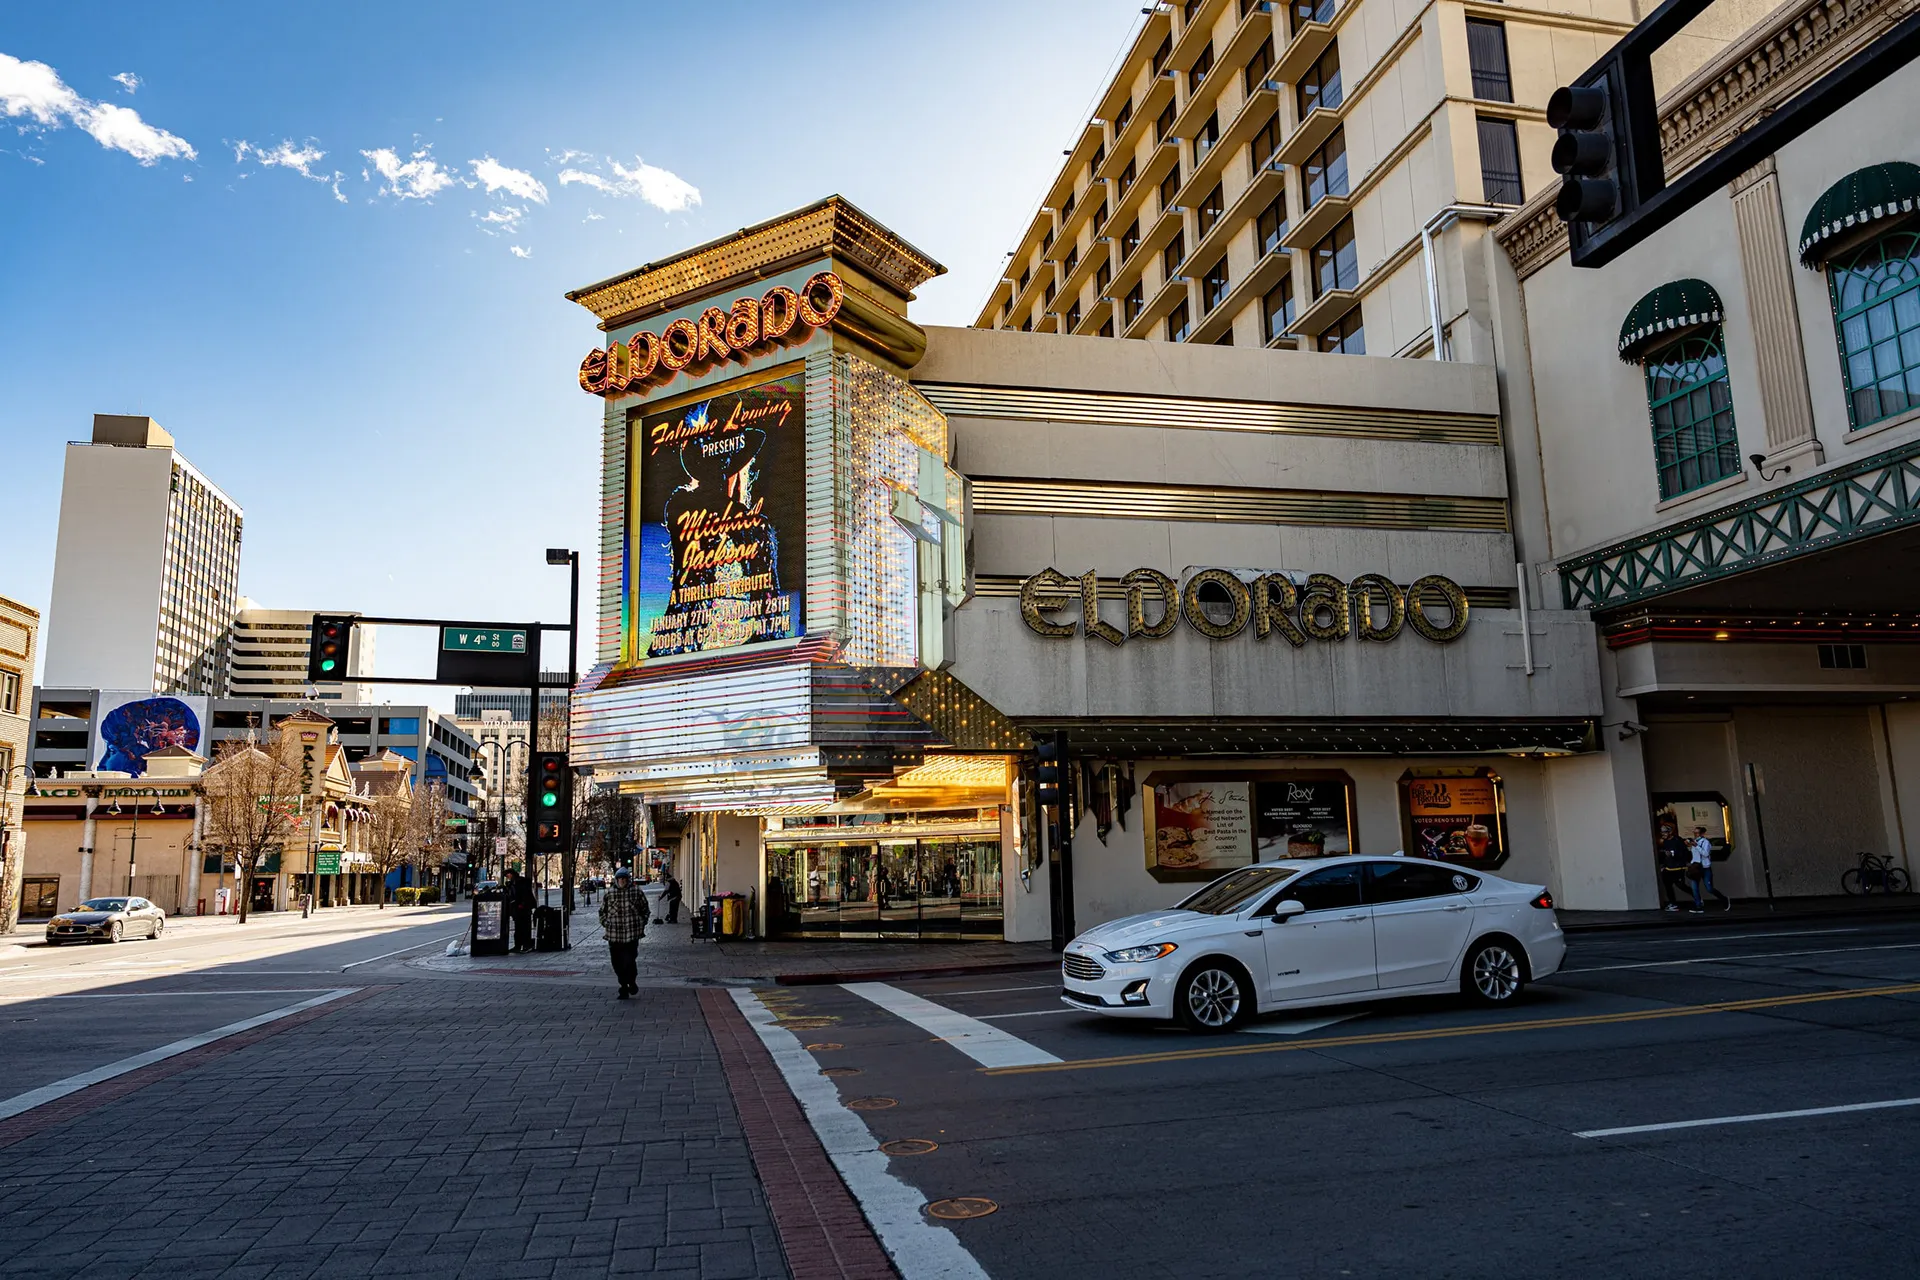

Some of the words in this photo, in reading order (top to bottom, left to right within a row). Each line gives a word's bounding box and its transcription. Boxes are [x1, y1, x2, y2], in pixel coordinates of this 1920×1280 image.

[702, 434, 746, 458] PRESENTS
[679, 534, 759, 586] Jackson
[670, 590, 677, 605] A
[679, 581, 727, 604] THRILLING
[650, 612, 689, 632] JANUARY
[690, 608, 713, 626] 27TH
[765, 595, 789, 614] 28TH
[459, 633, 468, 645] W
[473, 634, 487, 645] 4th
[492, 633, 500, 641] St
[652, 632, 682, 650] DOORS
[684, 630, 695, 646] AT
[755, 618, 767, 636] AT
[769, 614, 791, 633] 7PM
[300, 744, 316, 795] PALACE
[104, 788, 148, 799] JEWELRY
[552, 824, 560, 838] 3
